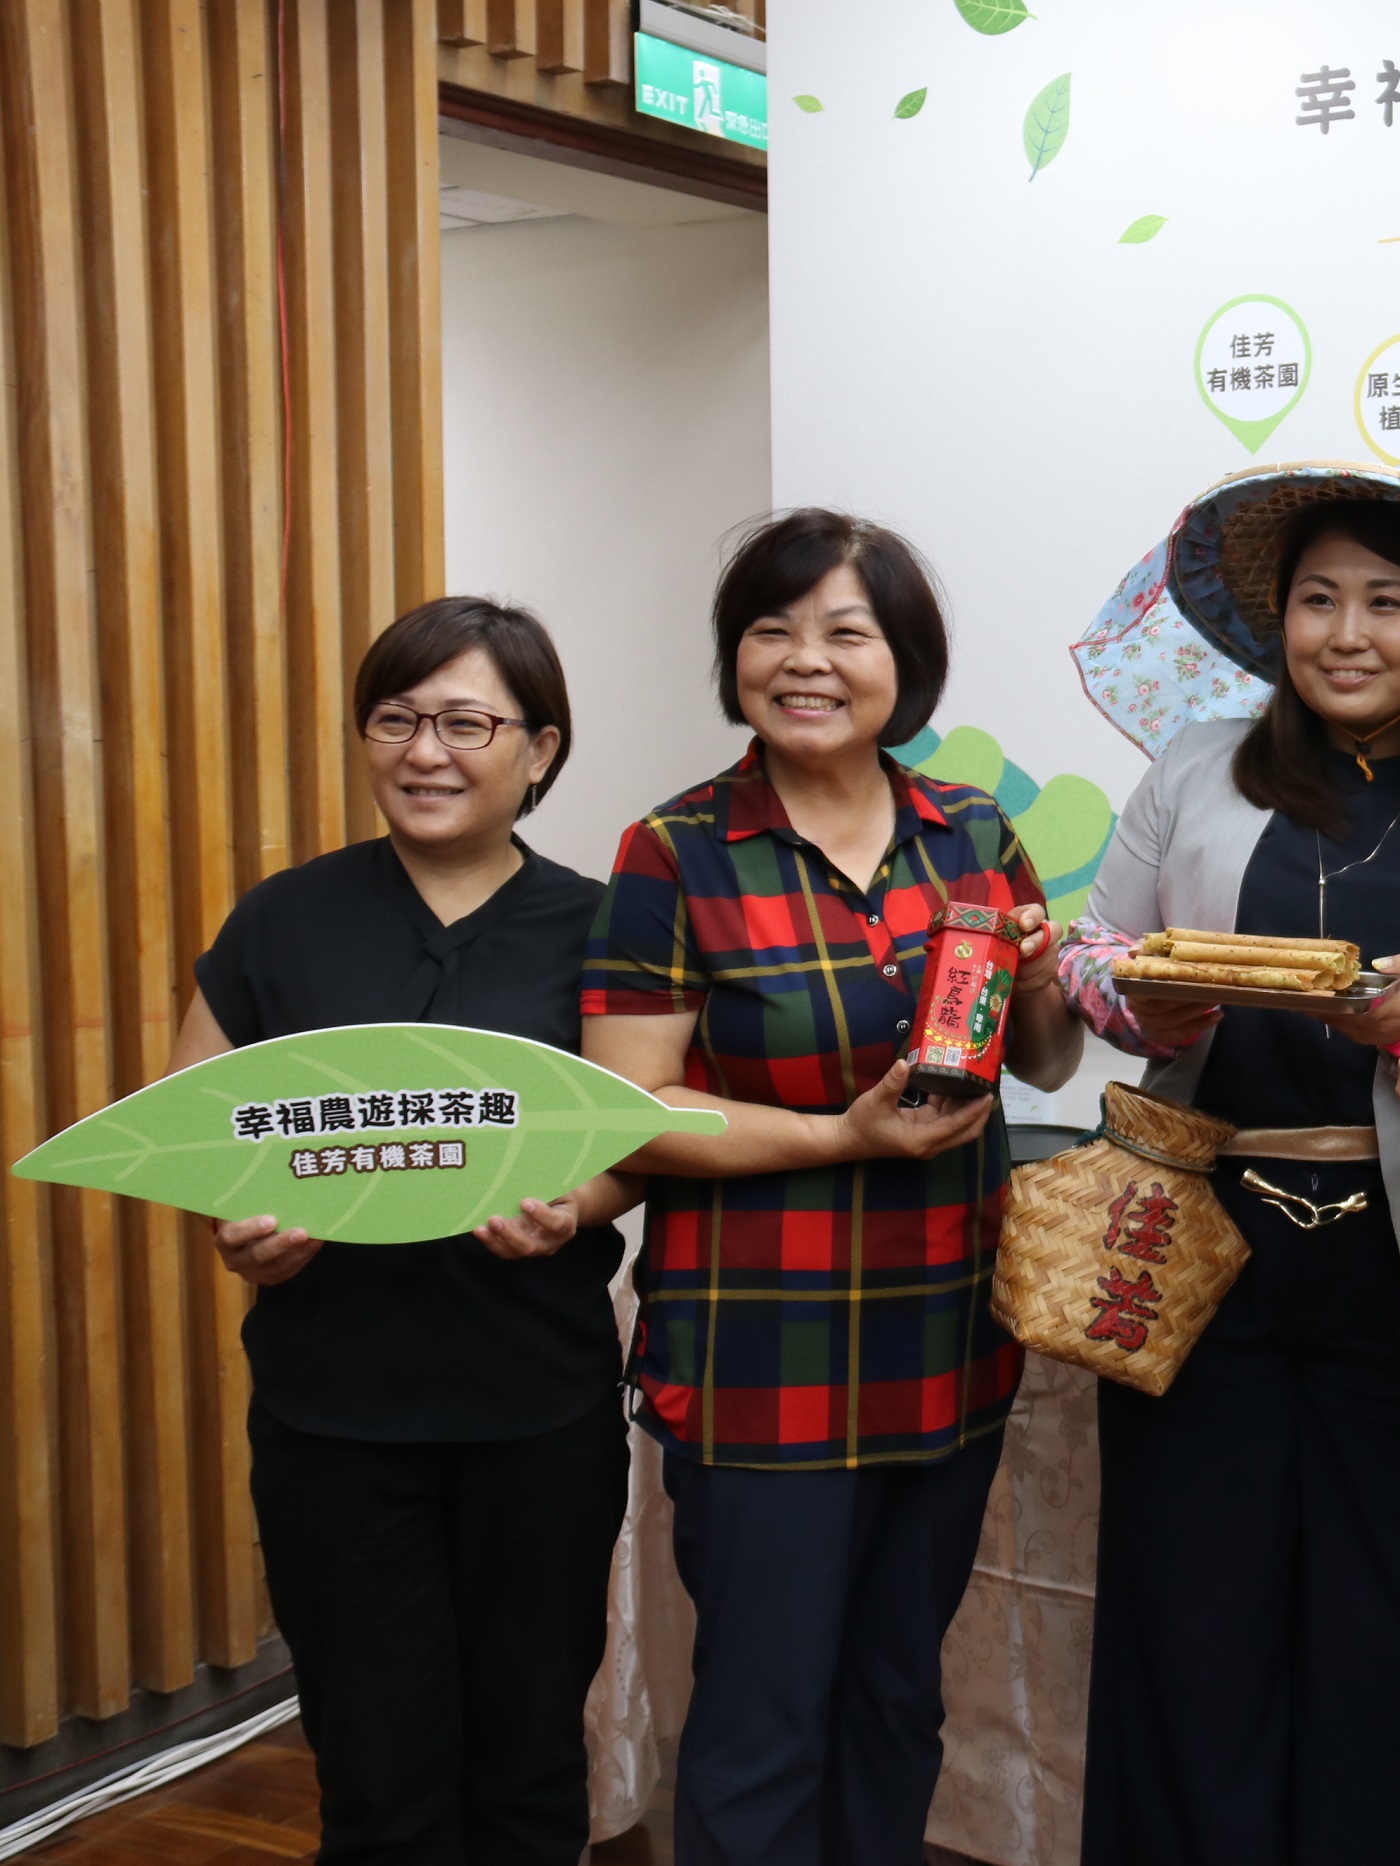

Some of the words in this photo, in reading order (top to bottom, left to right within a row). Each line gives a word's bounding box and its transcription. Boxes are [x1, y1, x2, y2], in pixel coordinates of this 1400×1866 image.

[641, 84, 689, 115] EXIT
[1229, 331, 1275, 359] 佳芳
[1206, 362, 1299, 393] 有機茶園
[235, 1091, 515, 1139] 幸福農遊採茶趣
[292, 1142, 463, 1176] 佳芳有機茶園
[1084, 1181, 1179, 1352] 佳芳
